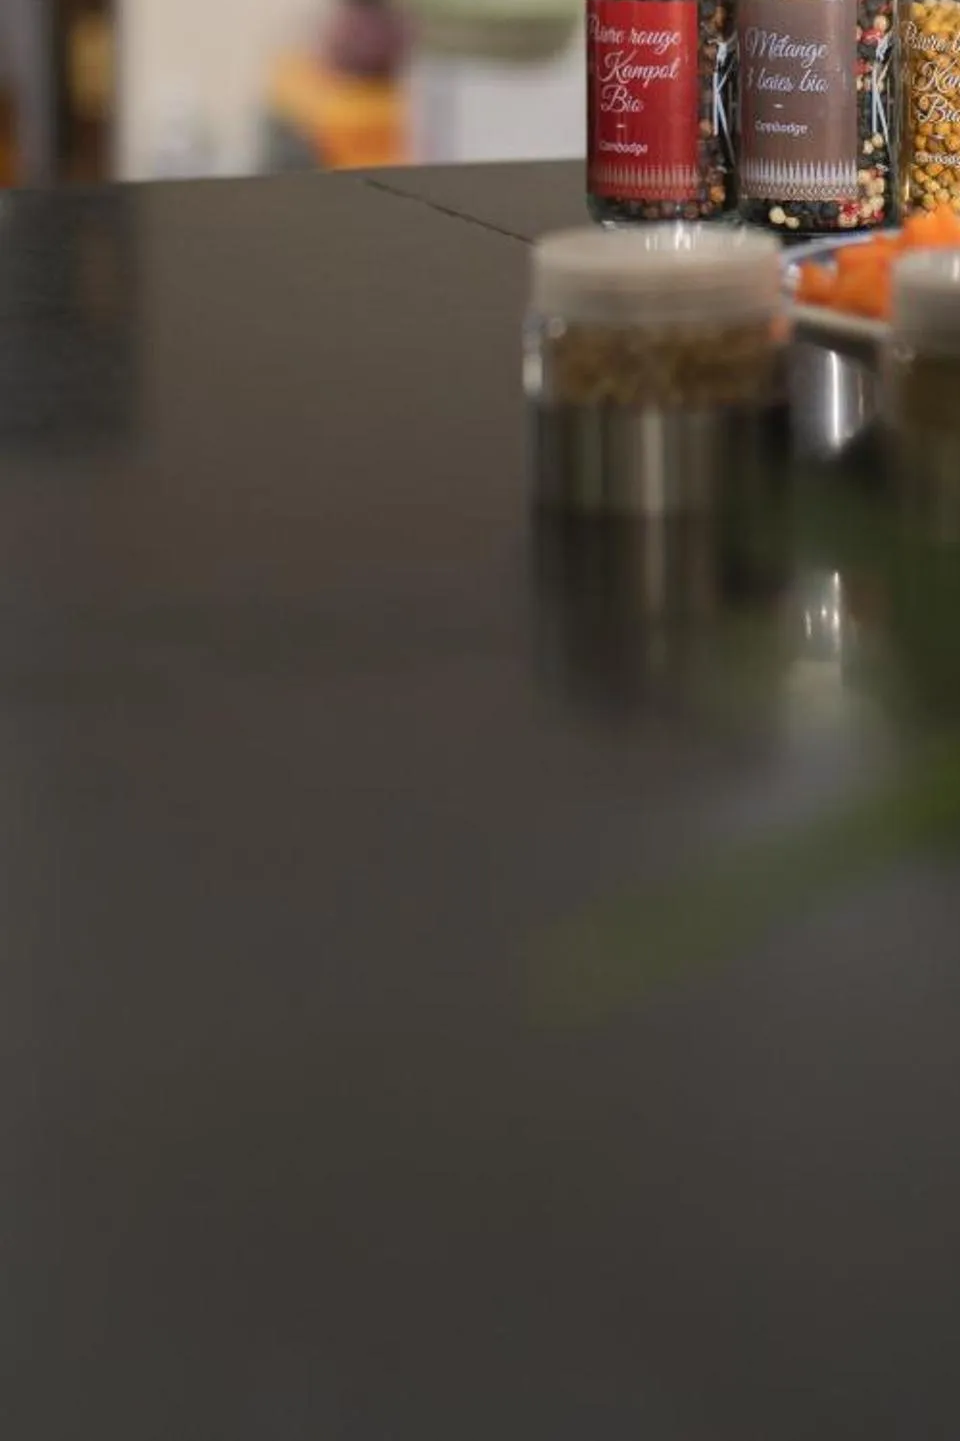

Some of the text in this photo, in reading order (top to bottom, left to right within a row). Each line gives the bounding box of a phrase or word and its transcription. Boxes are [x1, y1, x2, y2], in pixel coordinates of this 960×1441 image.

[630, 27, 682, 55] rouge
[799, 68, 829, 93] bio
[600, 83, 644, 112] Bio
